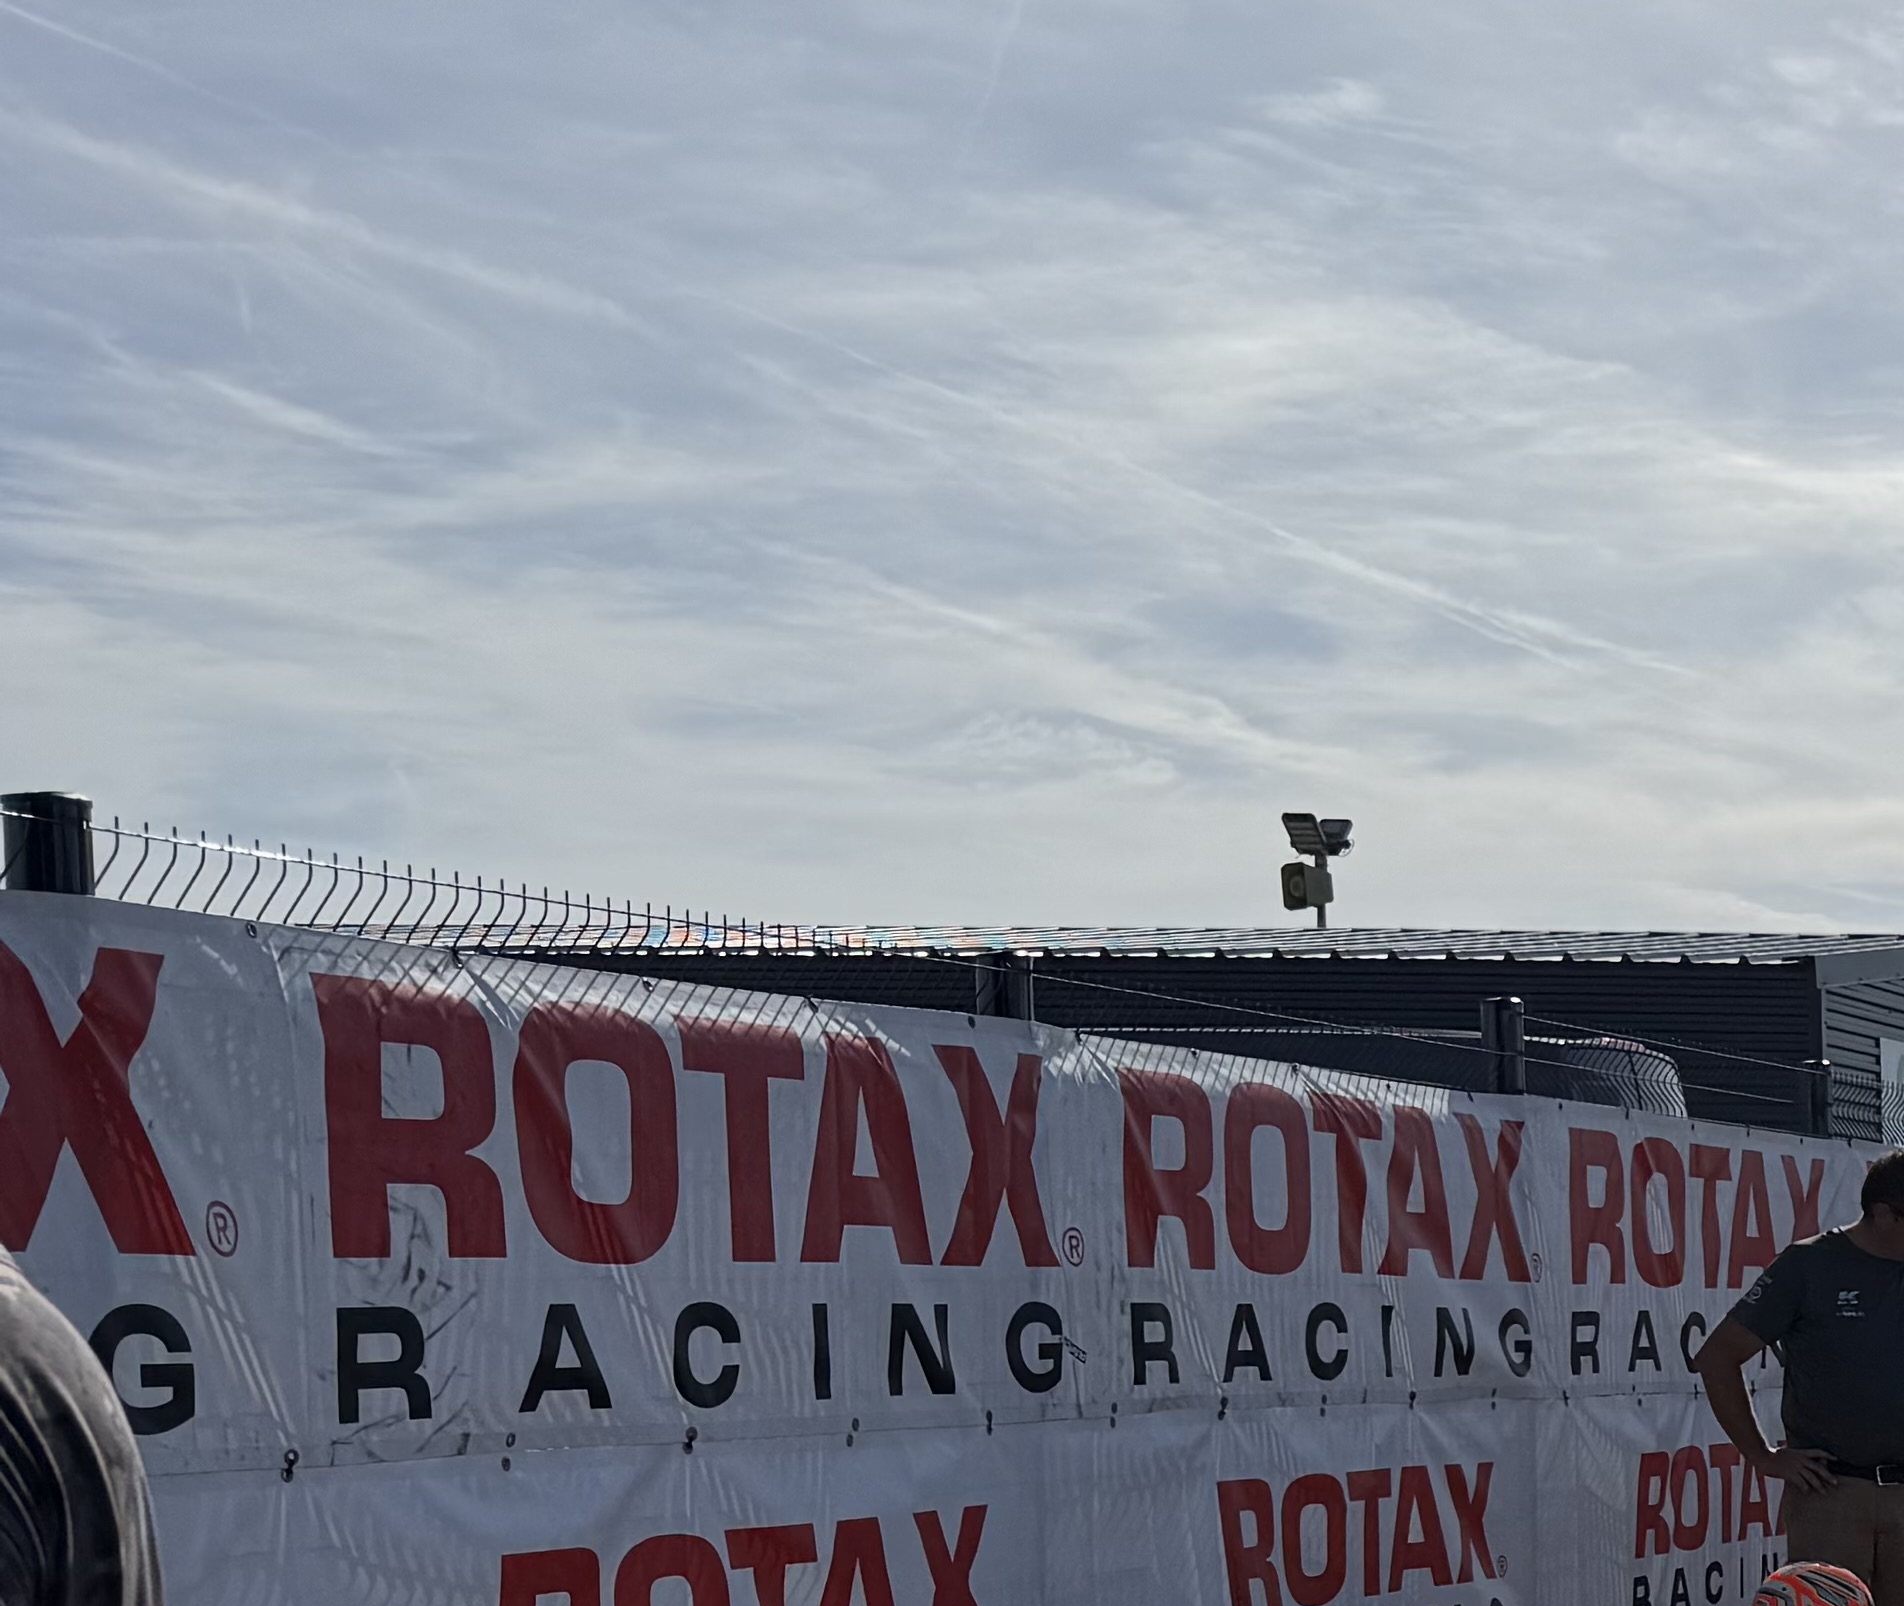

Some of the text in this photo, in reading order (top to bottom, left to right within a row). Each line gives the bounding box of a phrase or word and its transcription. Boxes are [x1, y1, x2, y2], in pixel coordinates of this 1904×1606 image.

[310, 972, 1062, 1268] ROTAX
[1118, 1067, 1532, 1283] ROTAX
[1569, 1127, 1825, 1289] ROTAX
[336, 1301, 1065, 1425] RACING
[1131, 1301, 1534, 1386] RACING
[1635, 1442, 1787, 1559] ROTA
